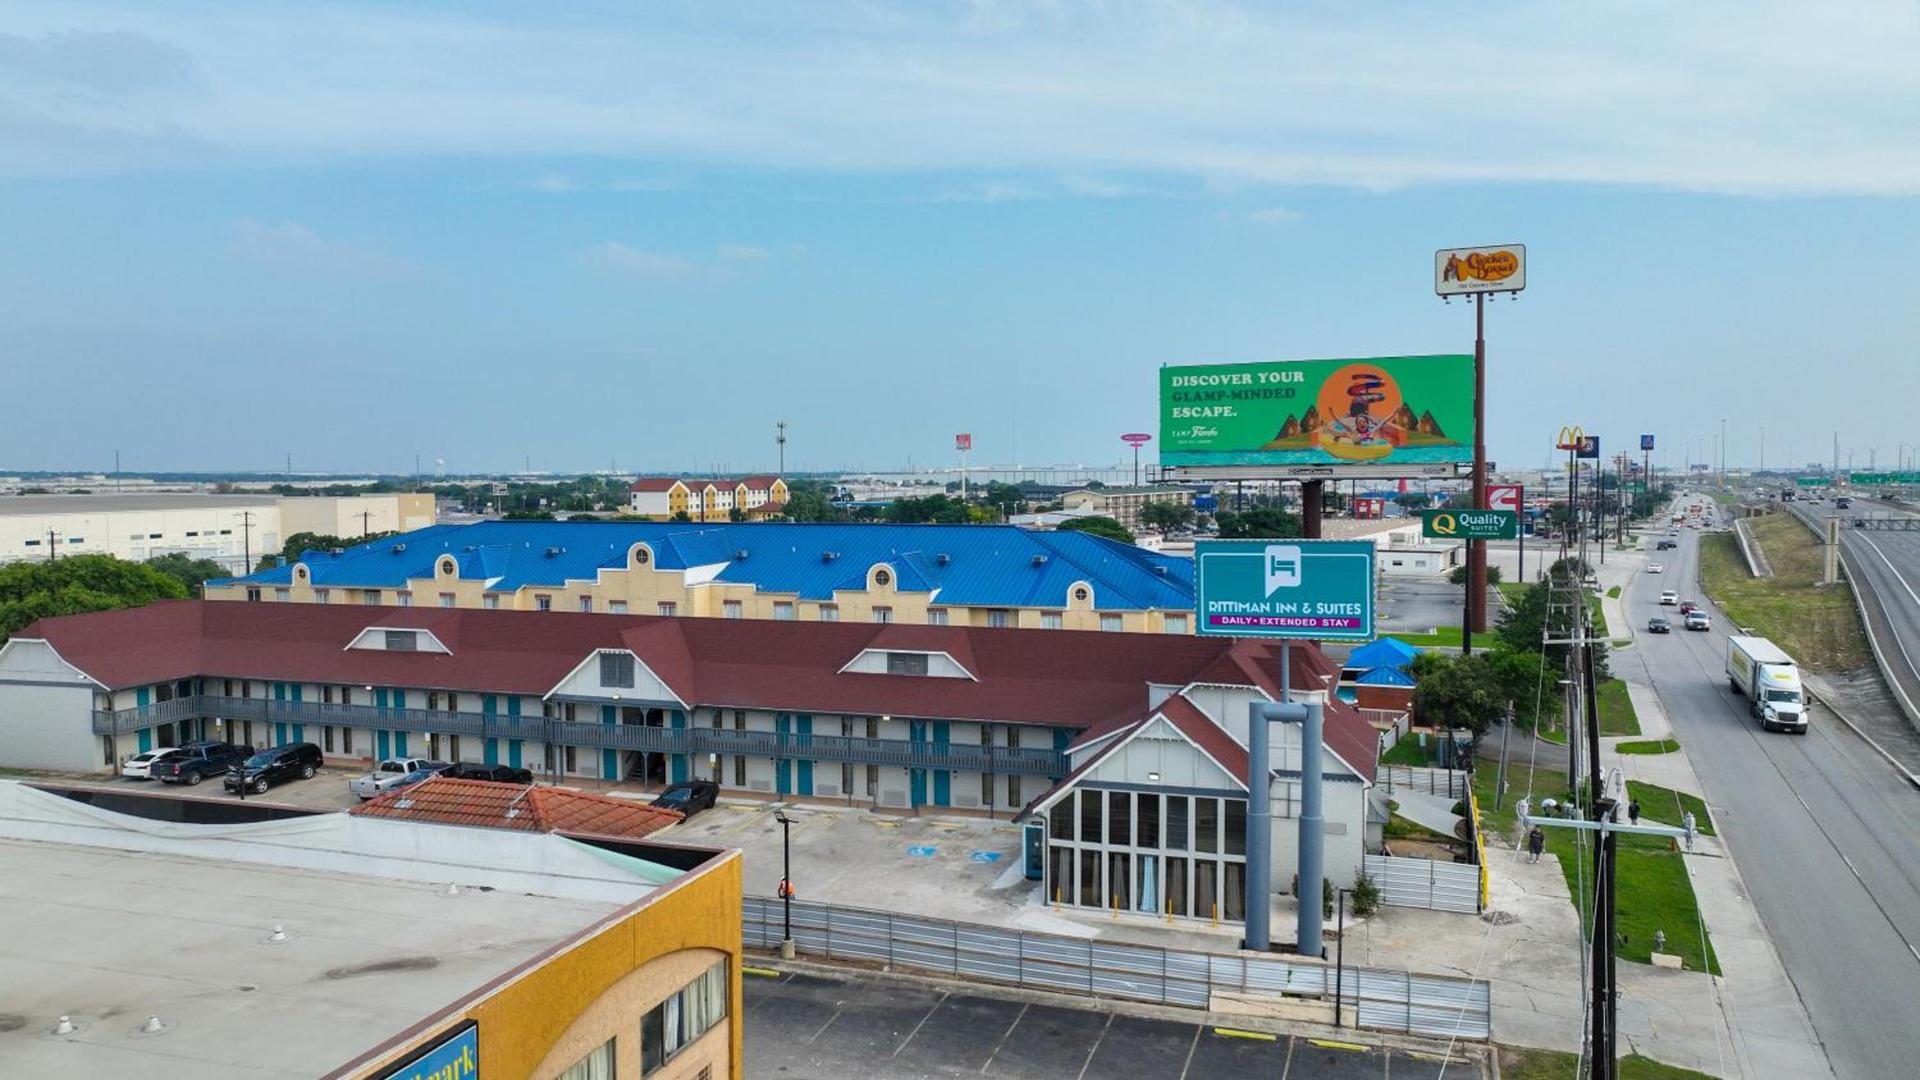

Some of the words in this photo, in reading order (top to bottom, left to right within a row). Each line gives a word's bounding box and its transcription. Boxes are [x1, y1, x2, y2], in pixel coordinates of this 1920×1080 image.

[1172, 374, 1253, 387] DISCOVER
[1258, 371, 1305, 384] YOUR
[1172, 387, 1296, 402] GLAMP-MINDED
[1172, 406, 1237, 418] ESCAPE.
[1459, 513, 1507, 527] Quality
[1208, 600, 1271, 614] RITTIMAN
[1276, 602, 1298, 614] INN
[1302, 602, 1312, 614] &
[1316, 602, 1362, 615] SUITES
[1260, 617, 1317, 627] EXTENDED
[1322, 618, 1350, 628] STAY
